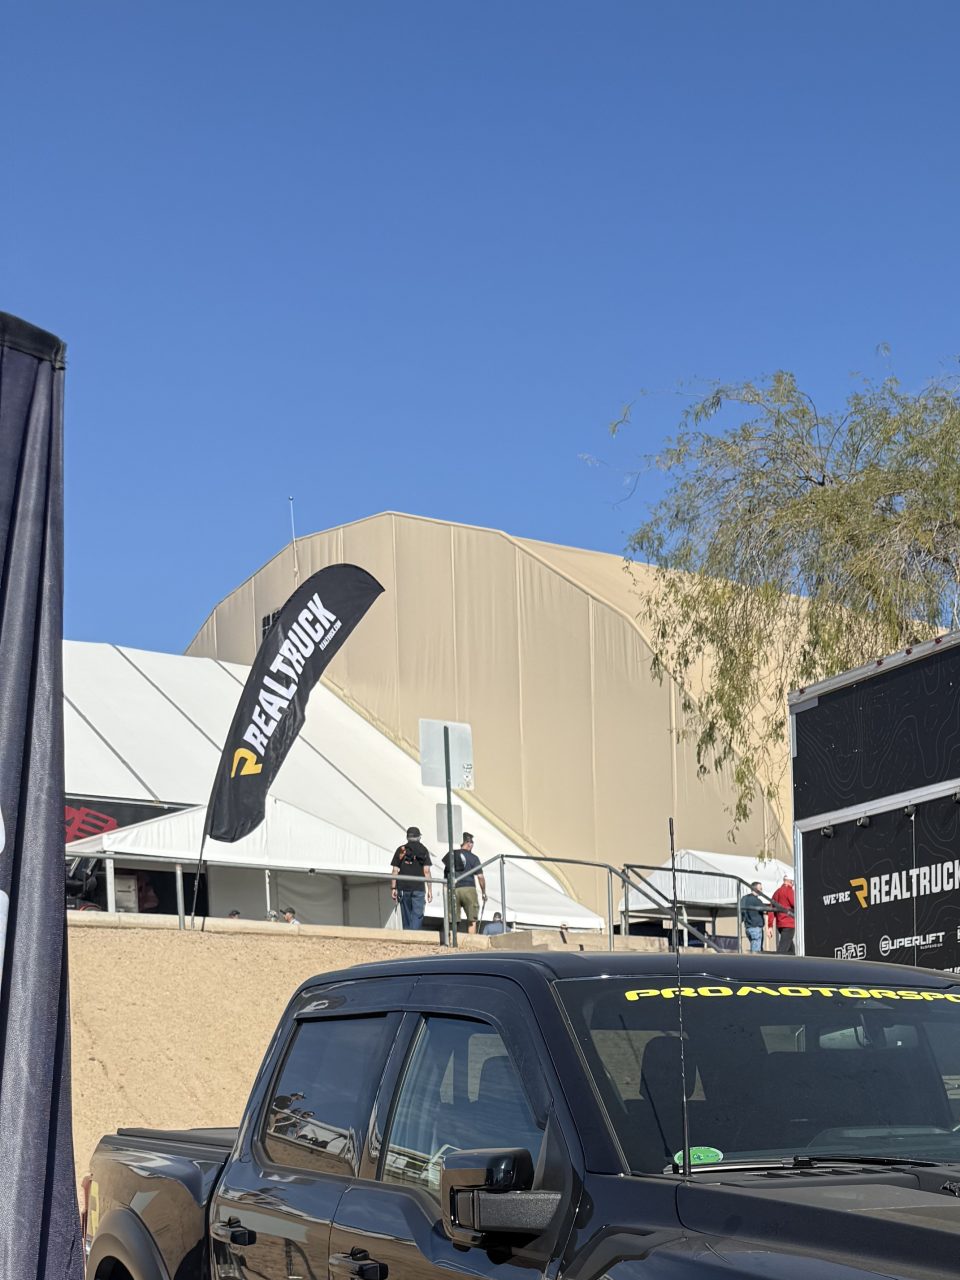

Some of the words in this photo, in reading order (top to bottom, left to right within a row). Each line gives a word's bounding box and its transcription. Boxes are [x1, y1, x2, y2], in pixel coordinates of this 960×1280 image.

[243, 593, 336, 757] REALTRUCK
[822, 891, 851, 906] WE'RE
[879, 932, 945, 956] SUPERLIFT
